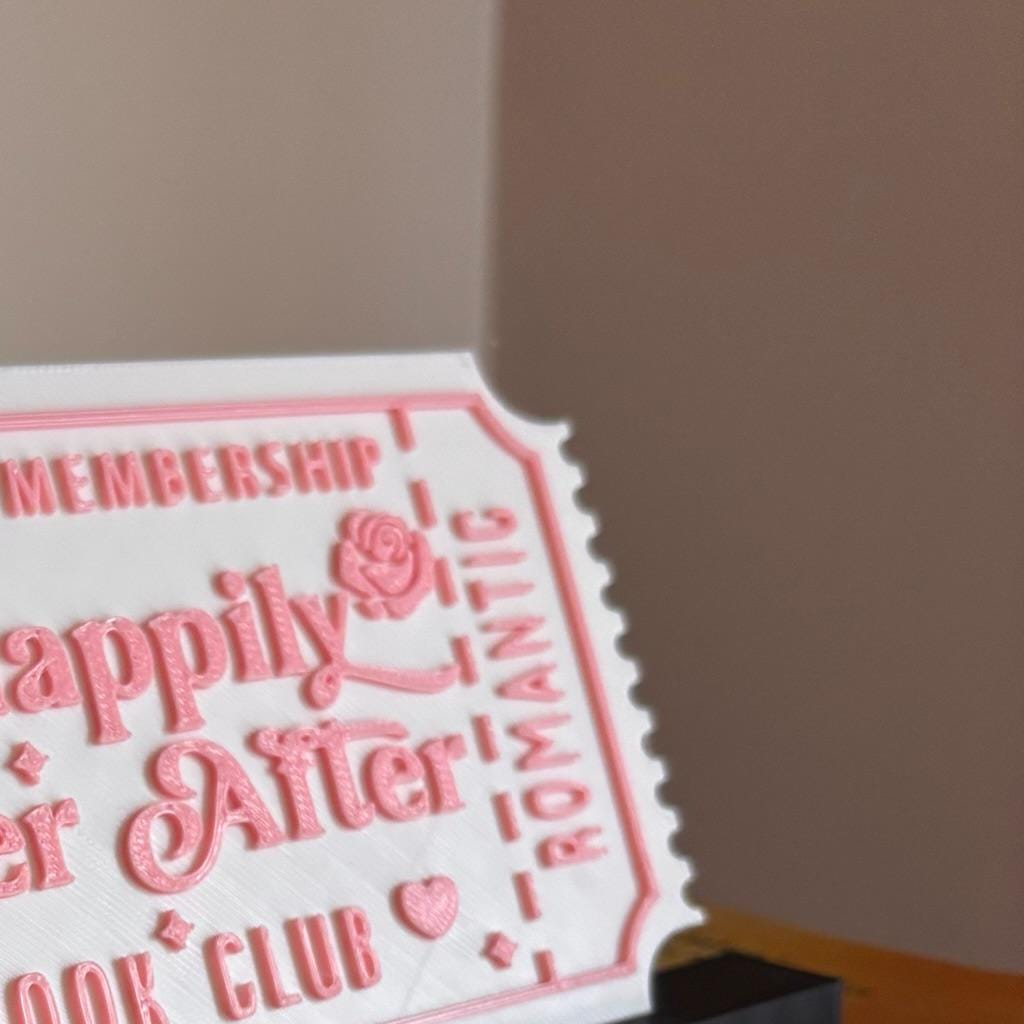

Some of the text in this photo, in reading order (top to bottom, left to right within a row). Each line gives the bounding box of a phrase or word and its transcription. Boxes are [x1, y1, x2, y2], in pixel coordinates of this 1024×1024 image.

[450, 505, 610, 869] ROMANTIC
[119, 718, 466, 894] After
[203, 905, 382, 1022] CLUB
